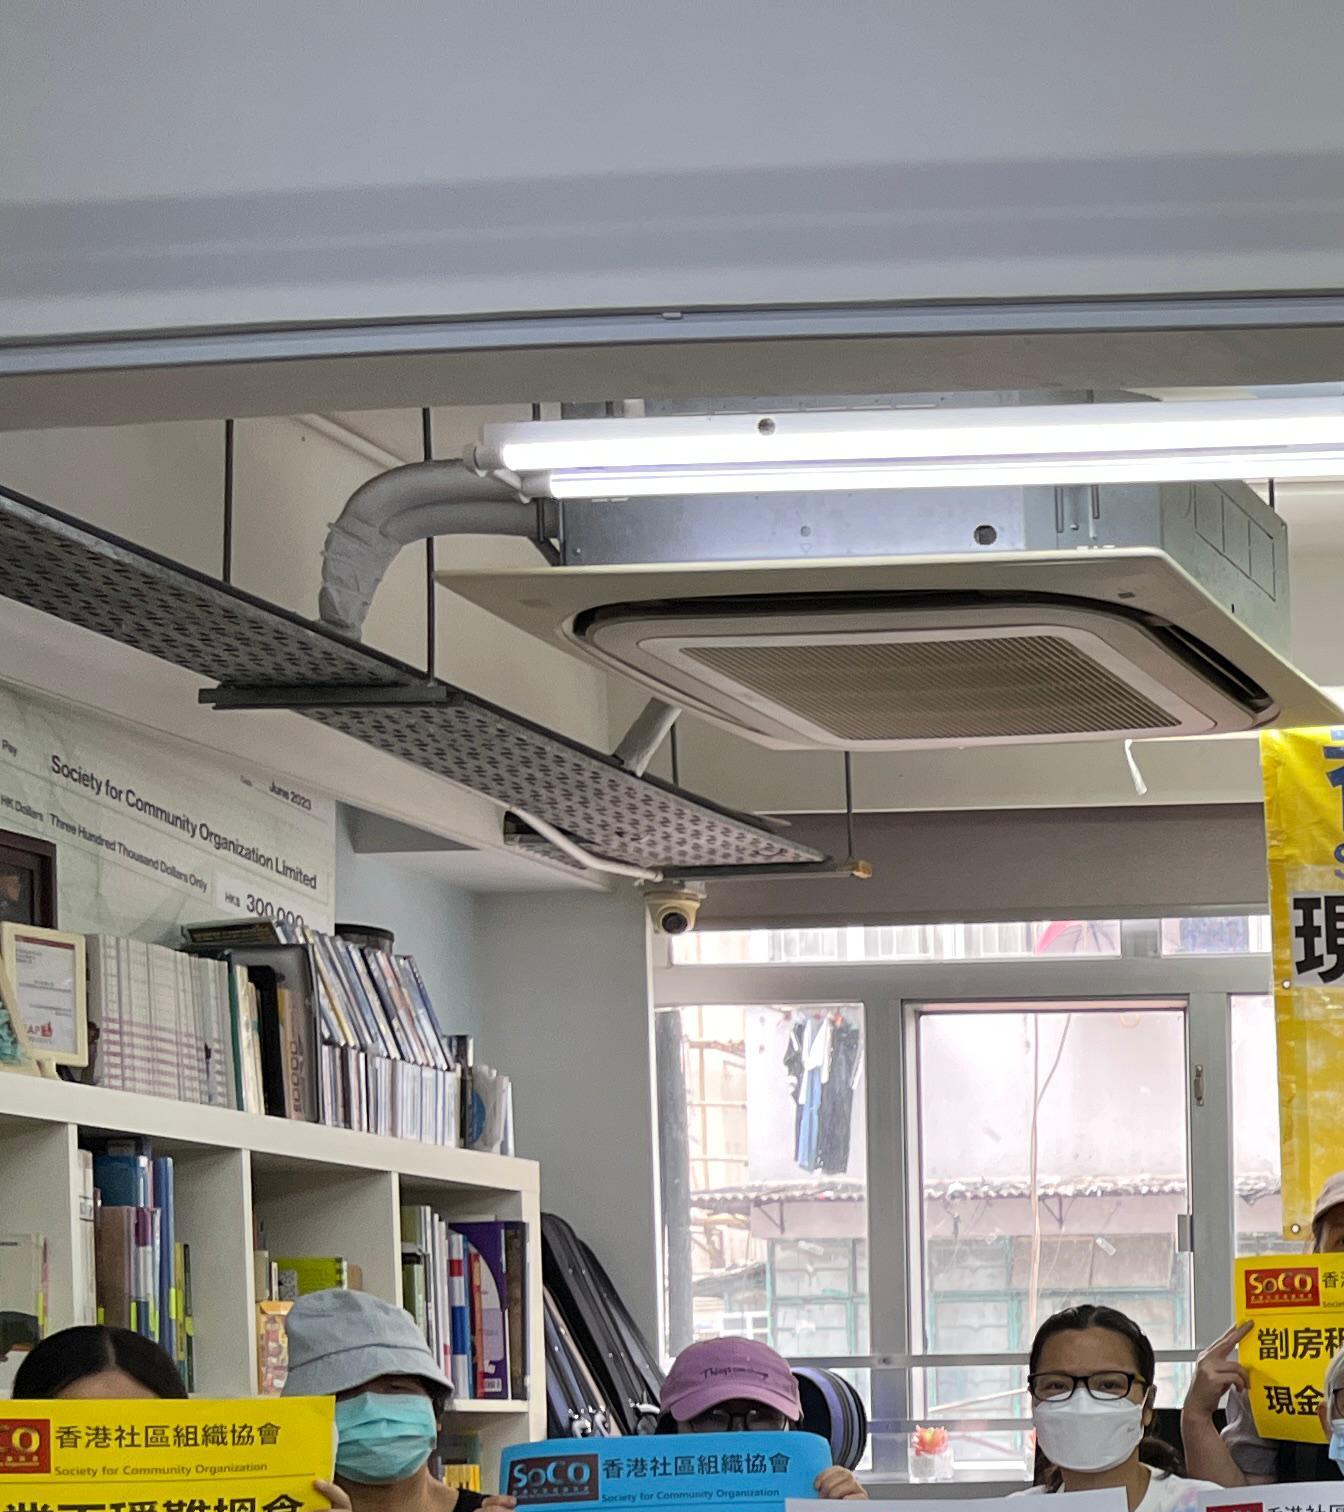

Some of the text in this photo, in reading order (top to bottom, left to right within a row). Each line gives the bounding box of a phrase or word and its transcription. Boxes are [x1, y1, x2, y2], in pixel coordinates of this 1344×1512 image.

[51, 755, 317, 889] Society for Community Organization Limited
[50, 813, 76, 835] Three
[78, 824, 117, 851] Hundred
[117, 841, 158, 870] Thousand
[160, 860, 188, 884] Dollars
[189, 874, 208, 893] Only
[55, 1422, 281, 1449] 香港社區組織協會
[54, 1462, 267, 1477] Society for Community Organization
[603, 1452, 790, 1480] 香港社區組織協會
